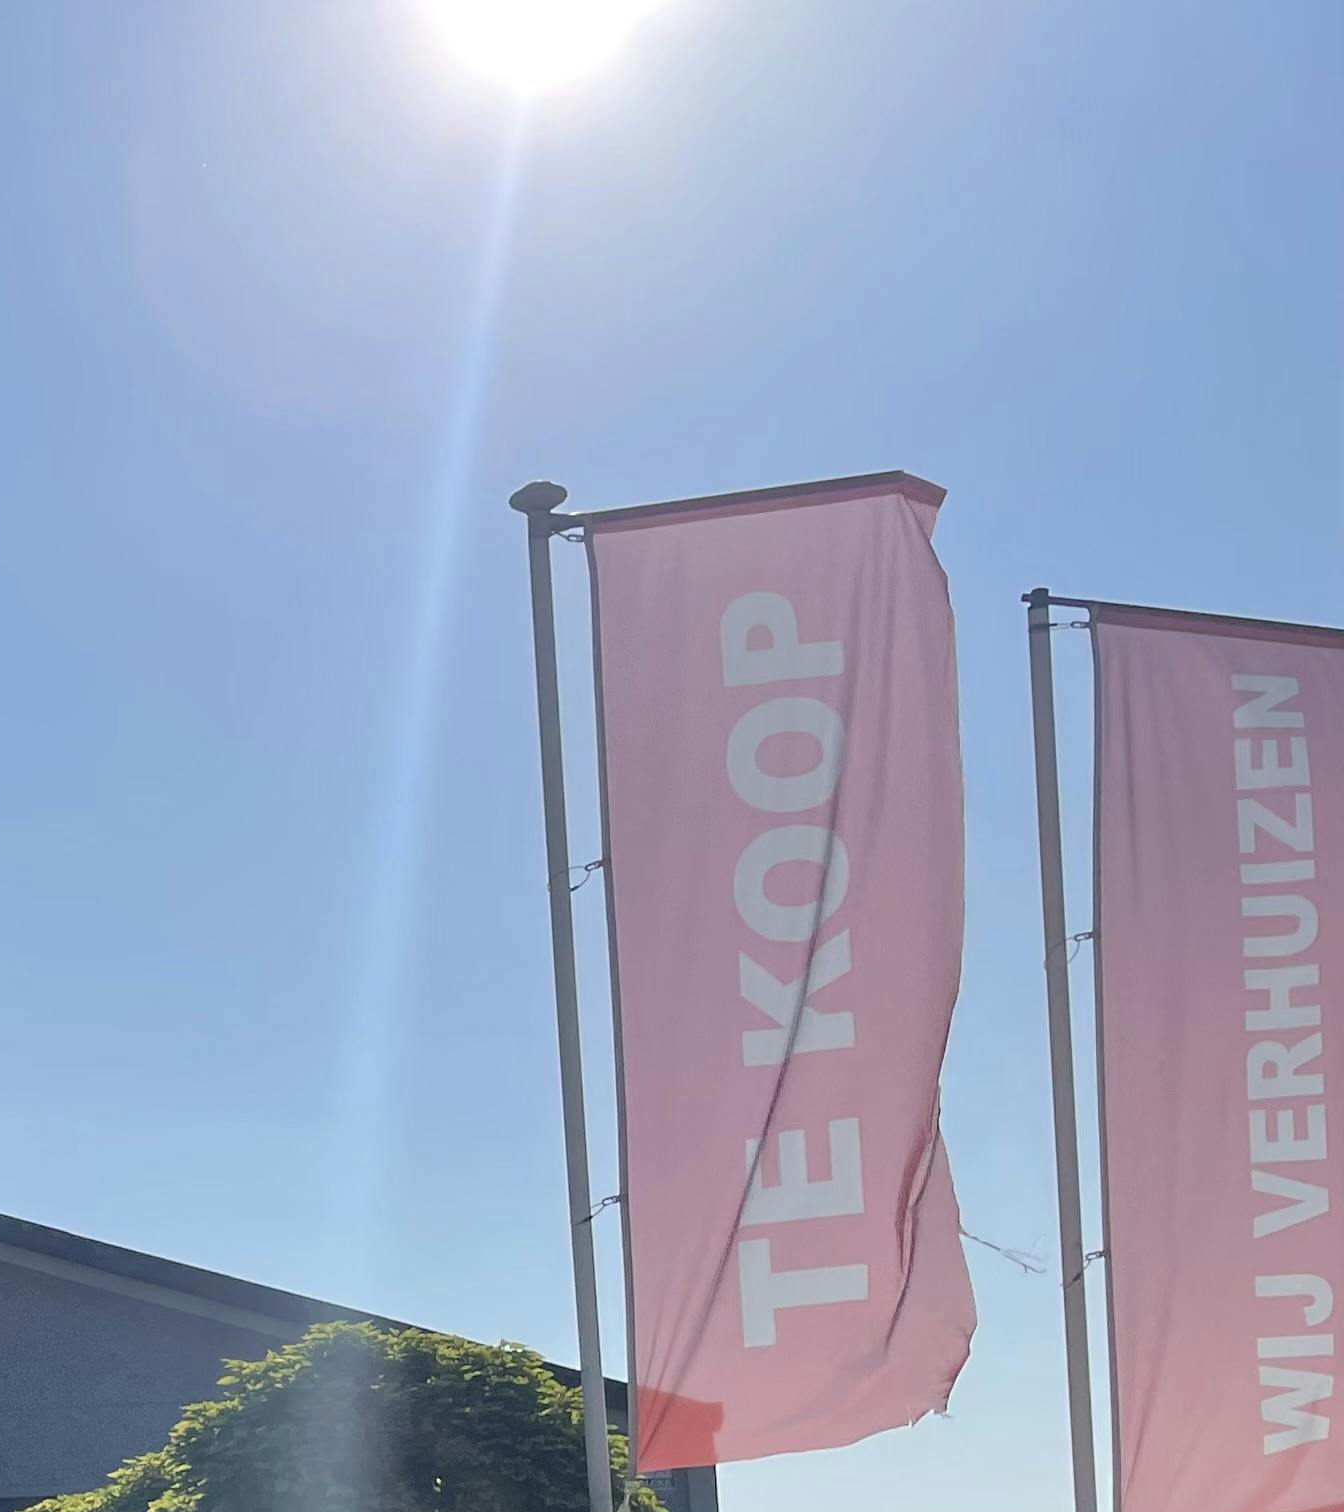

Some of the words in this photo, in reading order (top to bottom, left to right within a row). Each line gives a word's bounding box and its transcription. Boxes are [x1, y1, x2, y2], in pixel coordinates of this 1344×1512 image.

[720, 592, 856, 1067] KOOP
[1230, 673, 1330, 1239] VERHUIZEN
[738, 1117, 870, 1348] TE
[1255, 1274, 1334, 1456] WIJ
